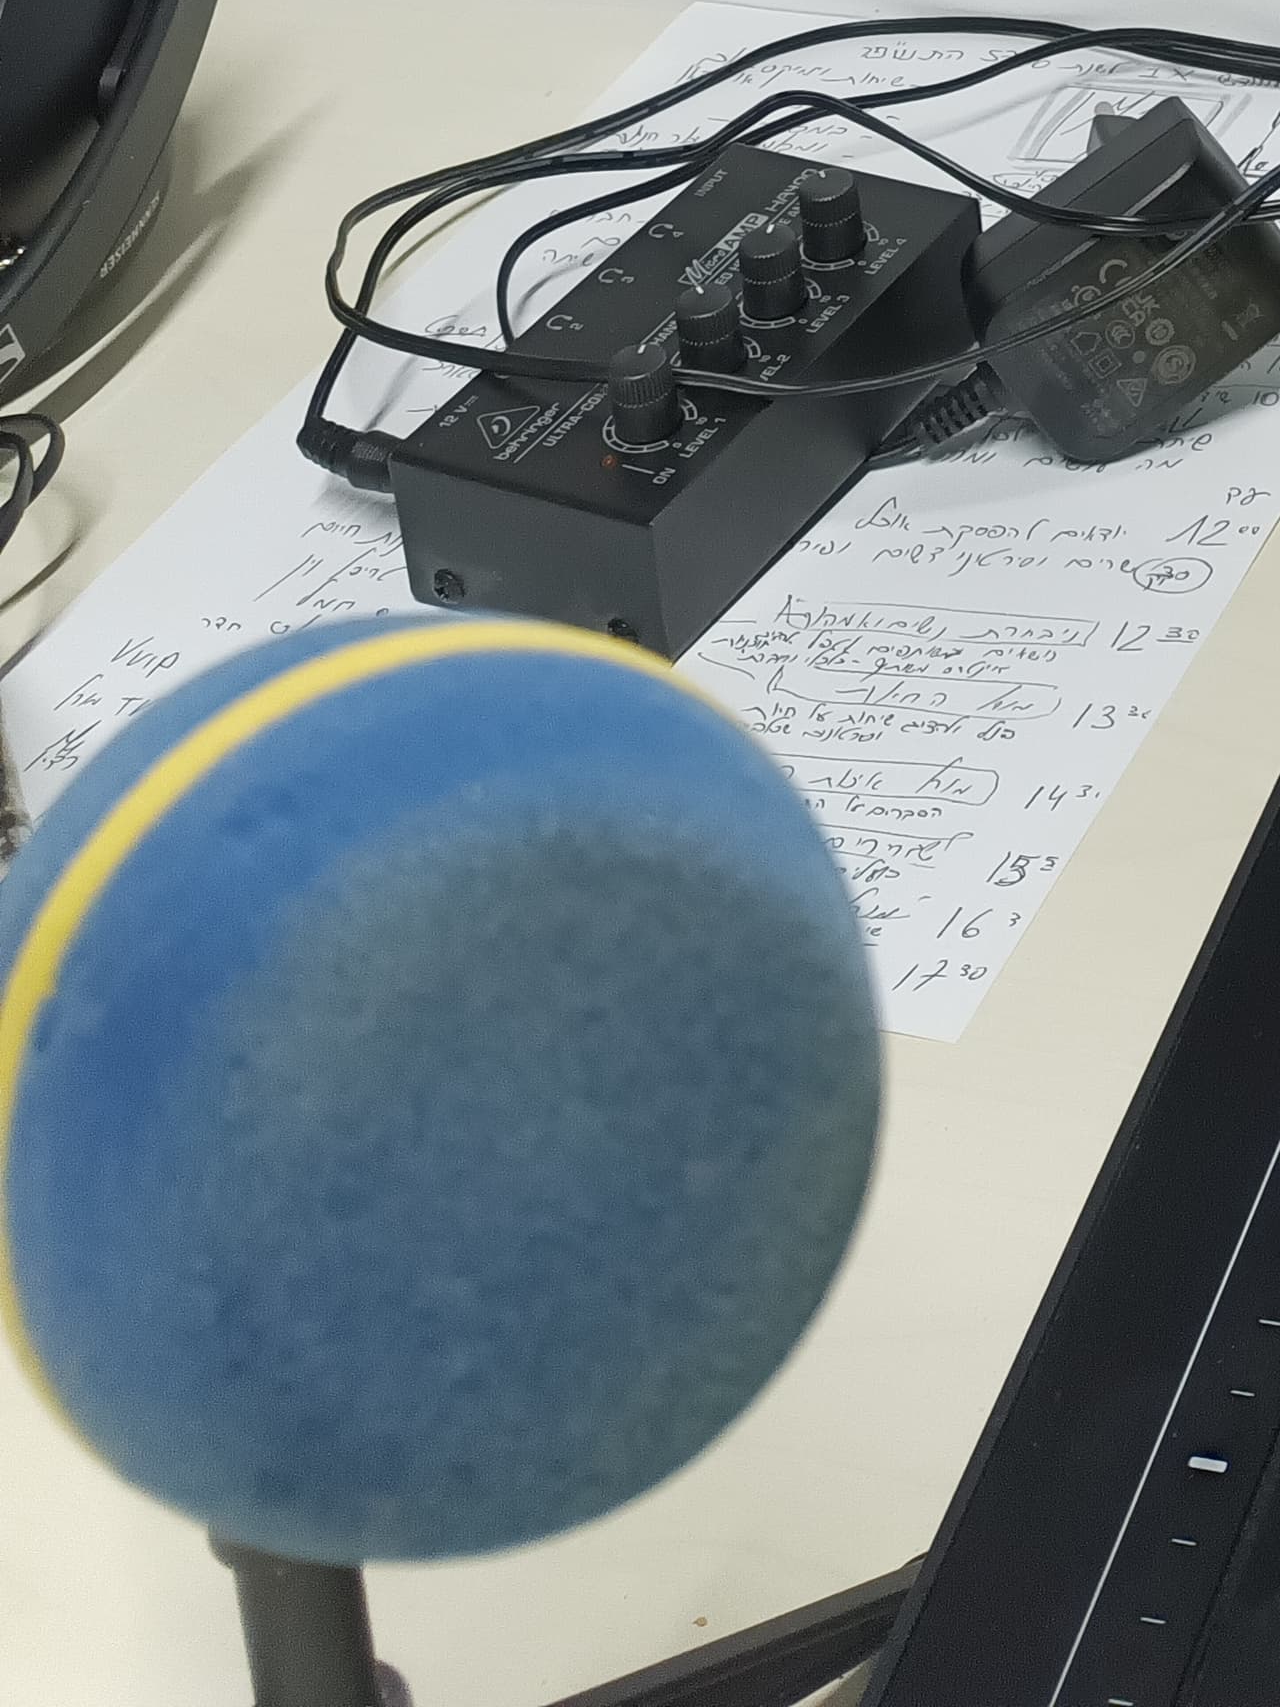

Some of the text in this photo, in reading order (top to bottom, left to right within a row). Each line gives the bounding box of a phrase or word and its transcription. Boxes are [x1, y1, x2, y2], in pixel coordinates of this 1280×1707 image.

[694, 168, 729, 198] INPUT
[864, 244, 900, 276] LEVEL
[806, 303, 842, 334] LEVEL
[493, 401, 561, 462] behringer
[680, 424, 720, 459] LEVEL
[652, 466, 677, 486] ON
